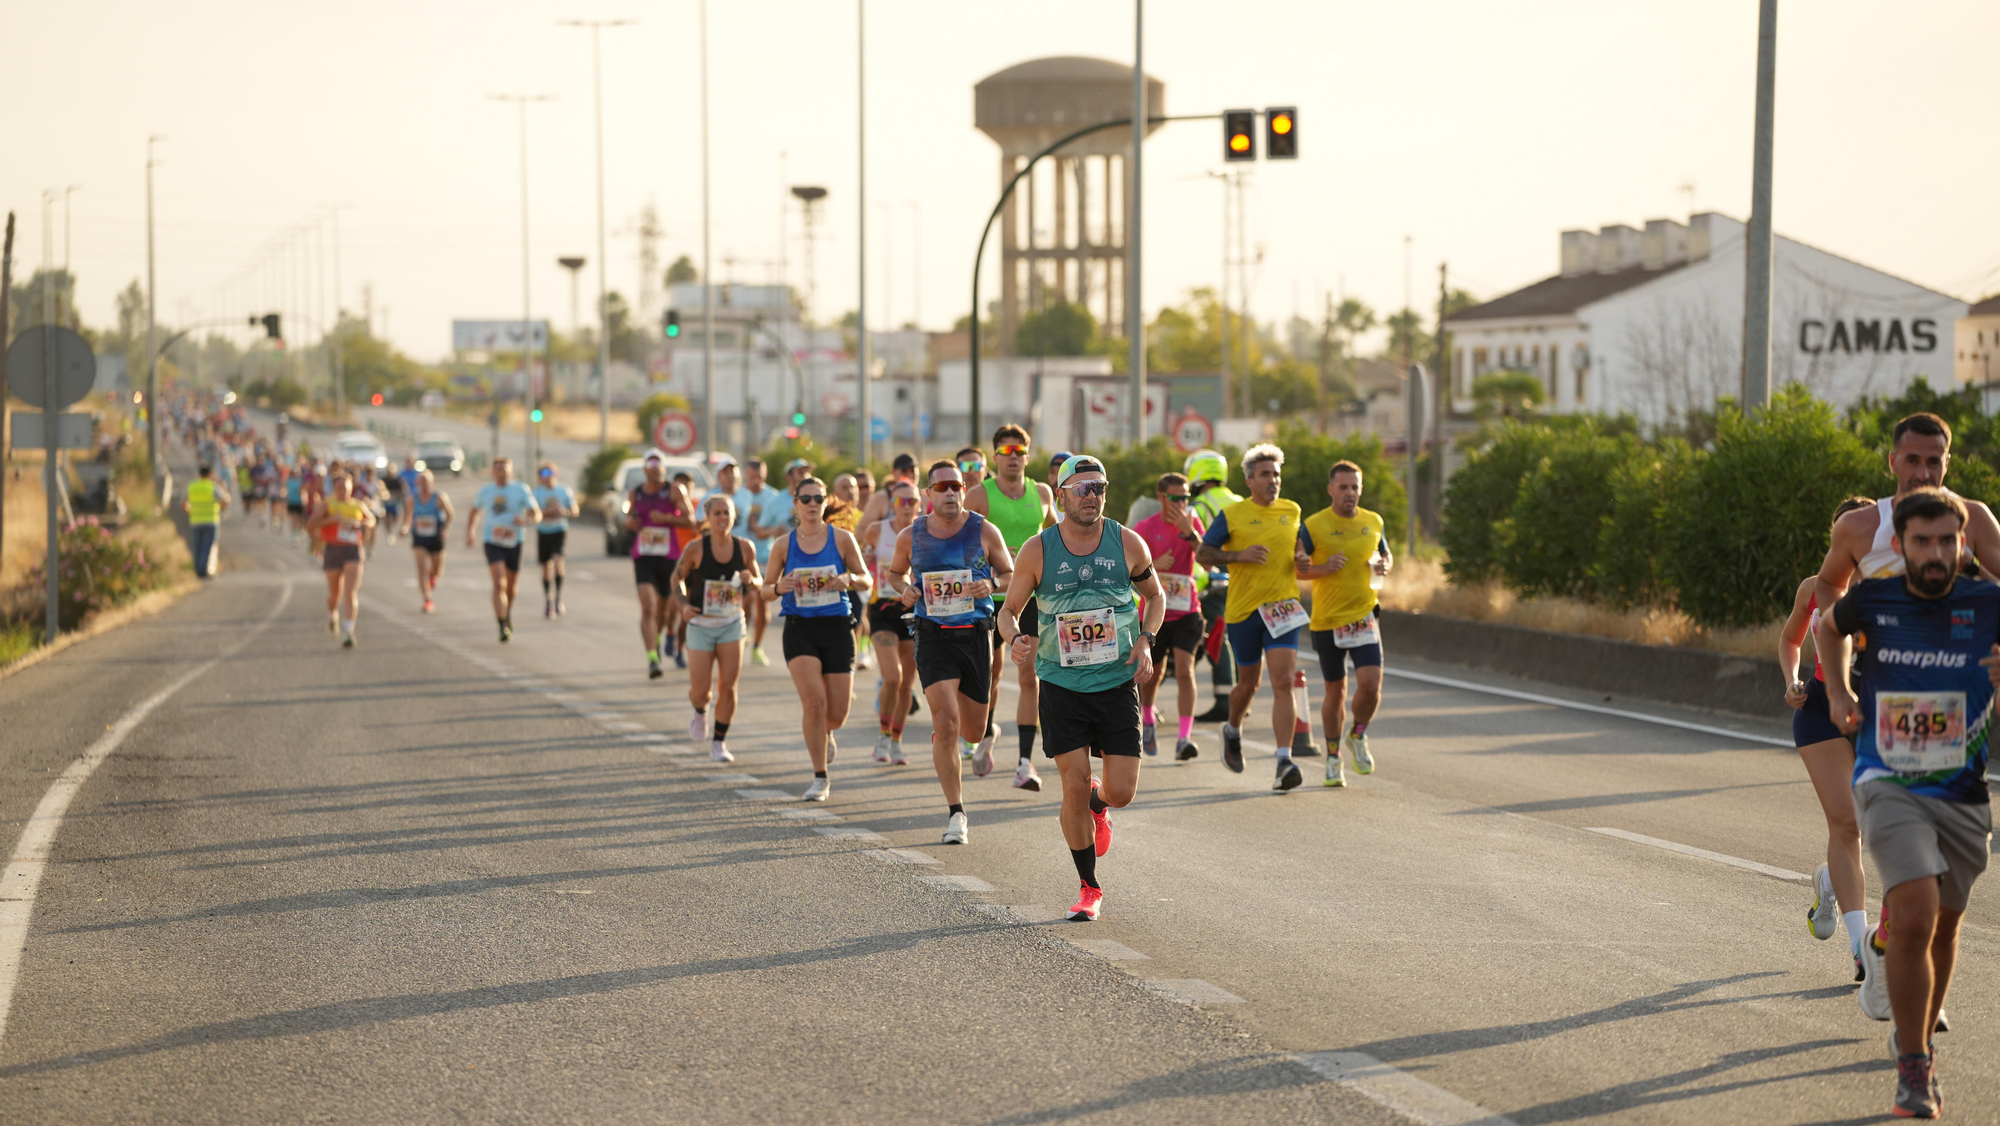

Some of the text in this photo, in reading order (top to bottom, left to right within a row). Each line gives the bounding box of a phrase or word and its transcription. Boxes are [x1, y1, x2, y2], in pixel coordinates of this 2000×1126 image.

[1800, 318, 1937, 353] CAMAS
[807, 577, 825, 589] 85
[933, 582, 963, 597] 320
[1272, 603, 1294, 618] 400
[1071, 623, 1105, 642] 502
[1877, 648, 1967, 669] enerplus
[1896, 713, 1947, 735] 485
